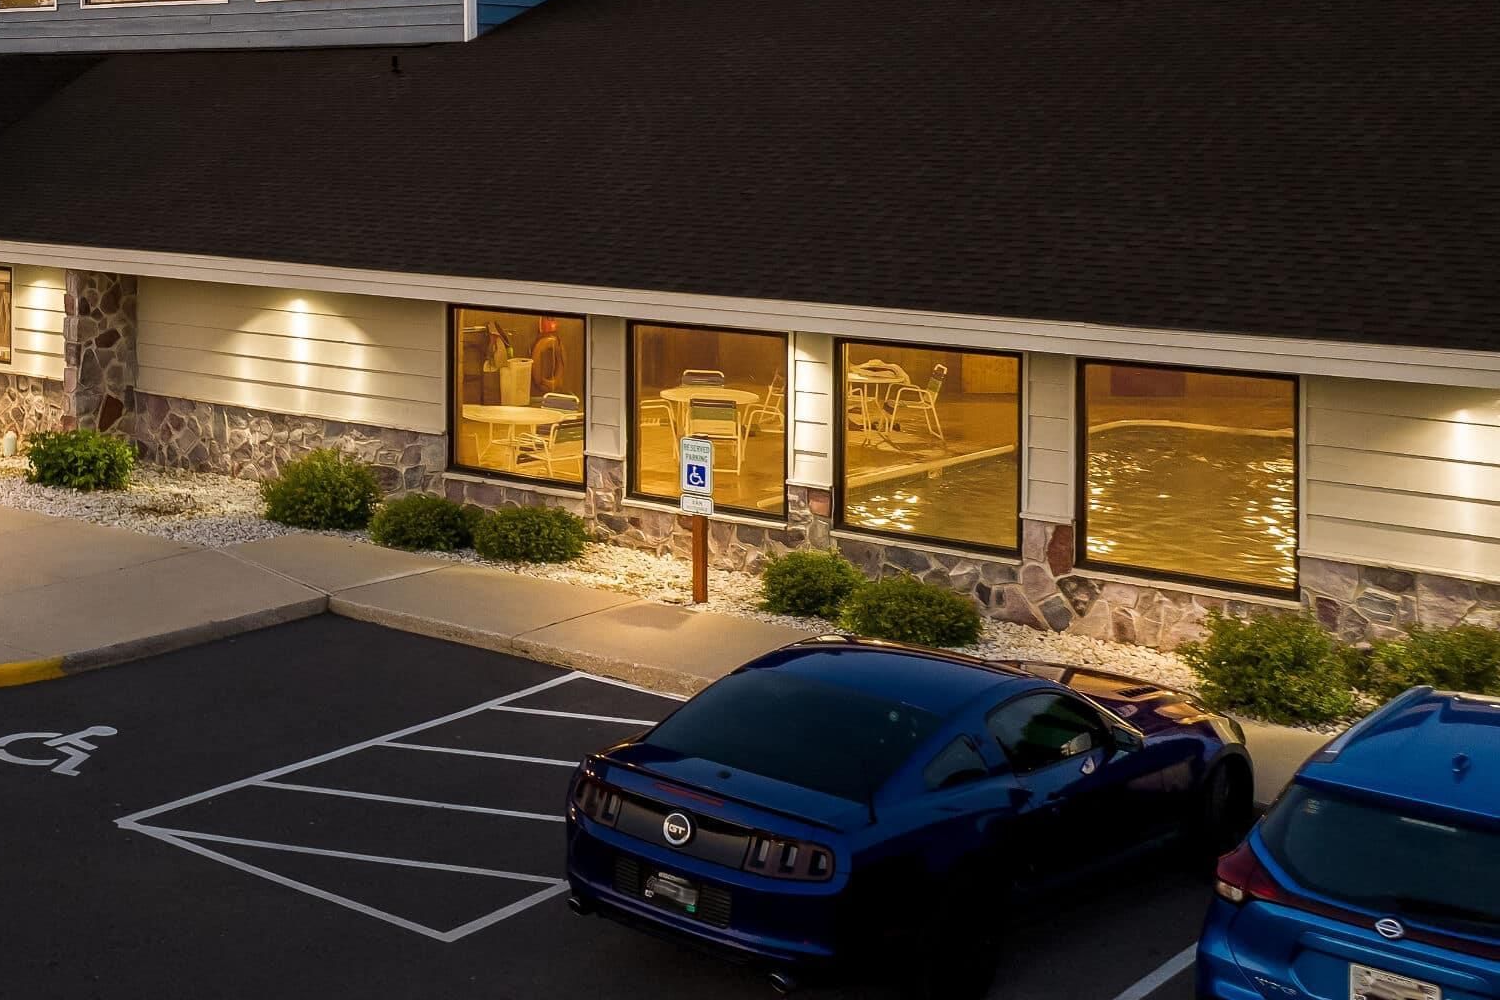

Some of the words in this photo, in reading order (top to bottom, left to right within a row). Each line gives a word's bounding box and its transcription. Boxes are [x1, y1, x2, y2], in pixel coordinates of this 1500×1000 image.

[684, 443, 709, 453] RESERVED
[685, 454, 708, 463] PARKING
[668, 824, 686, 834] GT
